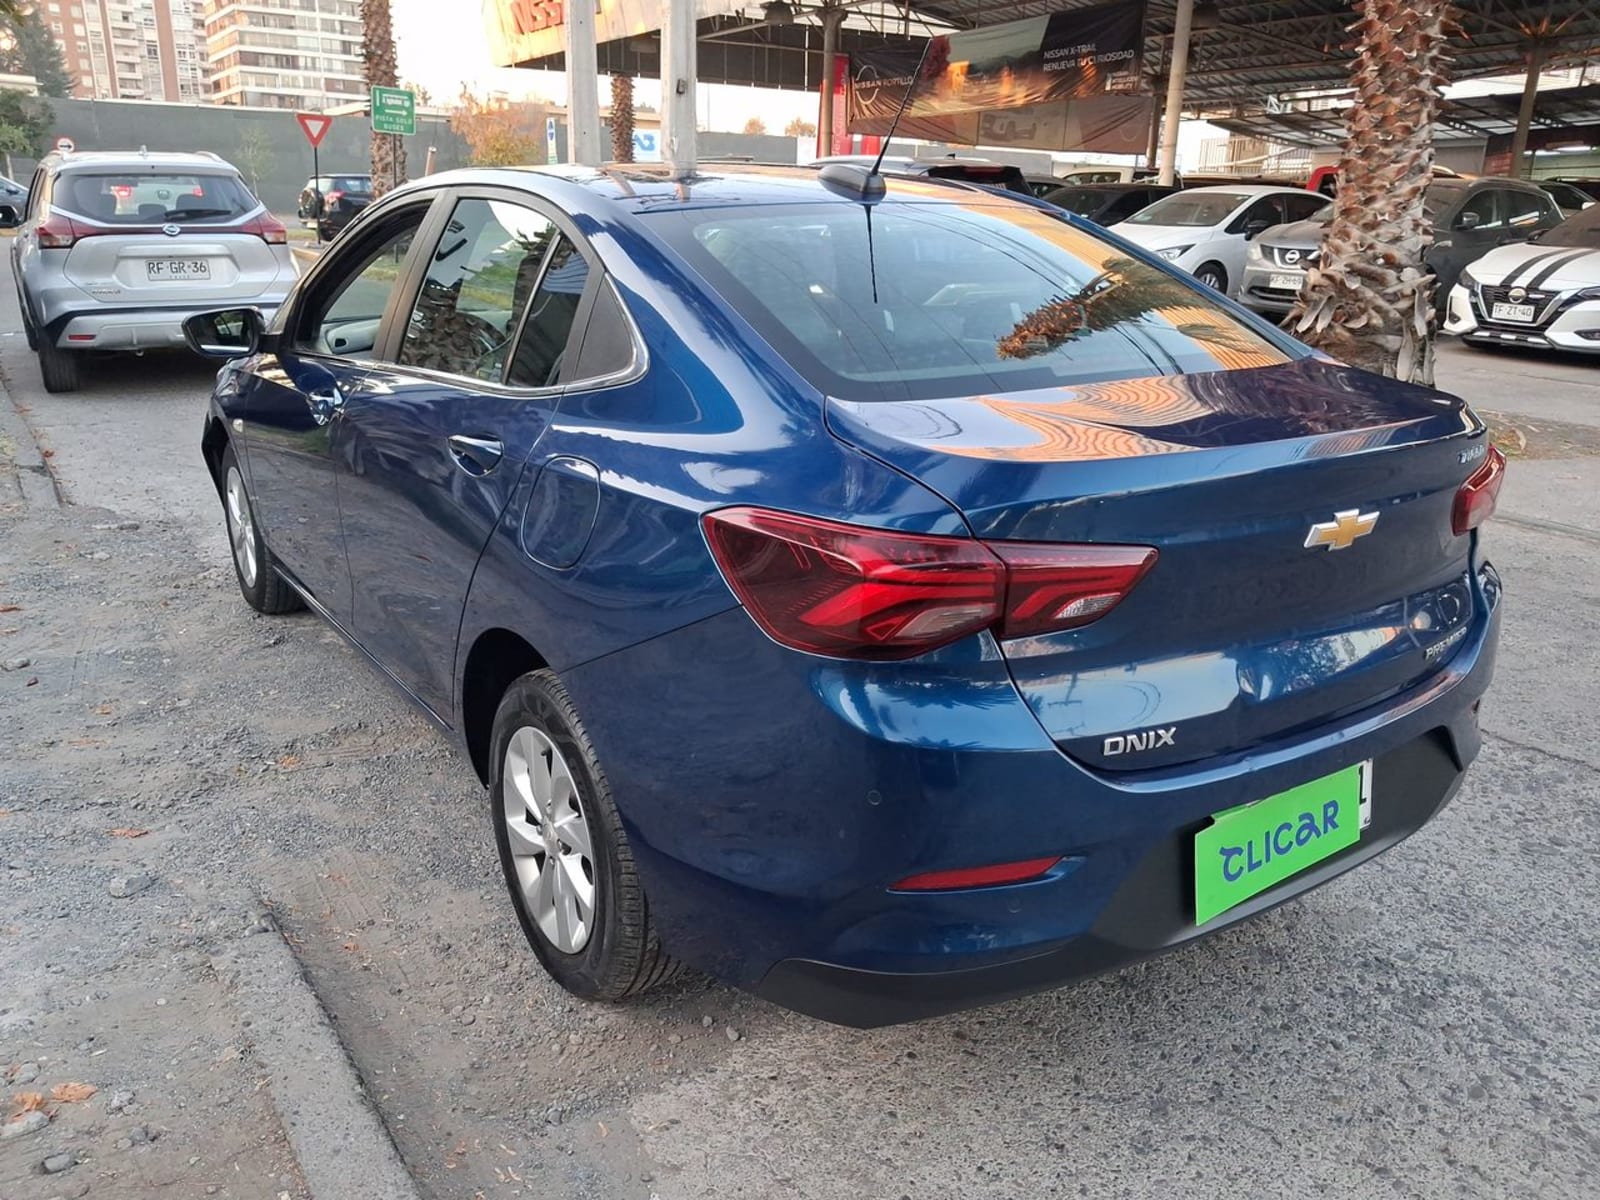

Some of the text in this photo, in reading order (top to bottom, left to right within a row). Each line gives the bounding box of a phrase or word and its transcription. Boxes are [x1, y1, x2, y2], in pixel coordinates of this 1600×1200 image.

[1043, 48, 1069, 59] NISSAN
[1043, 59, 1076, 72] RENUEVA
[1103, 726, 1177, 756] ONIX
